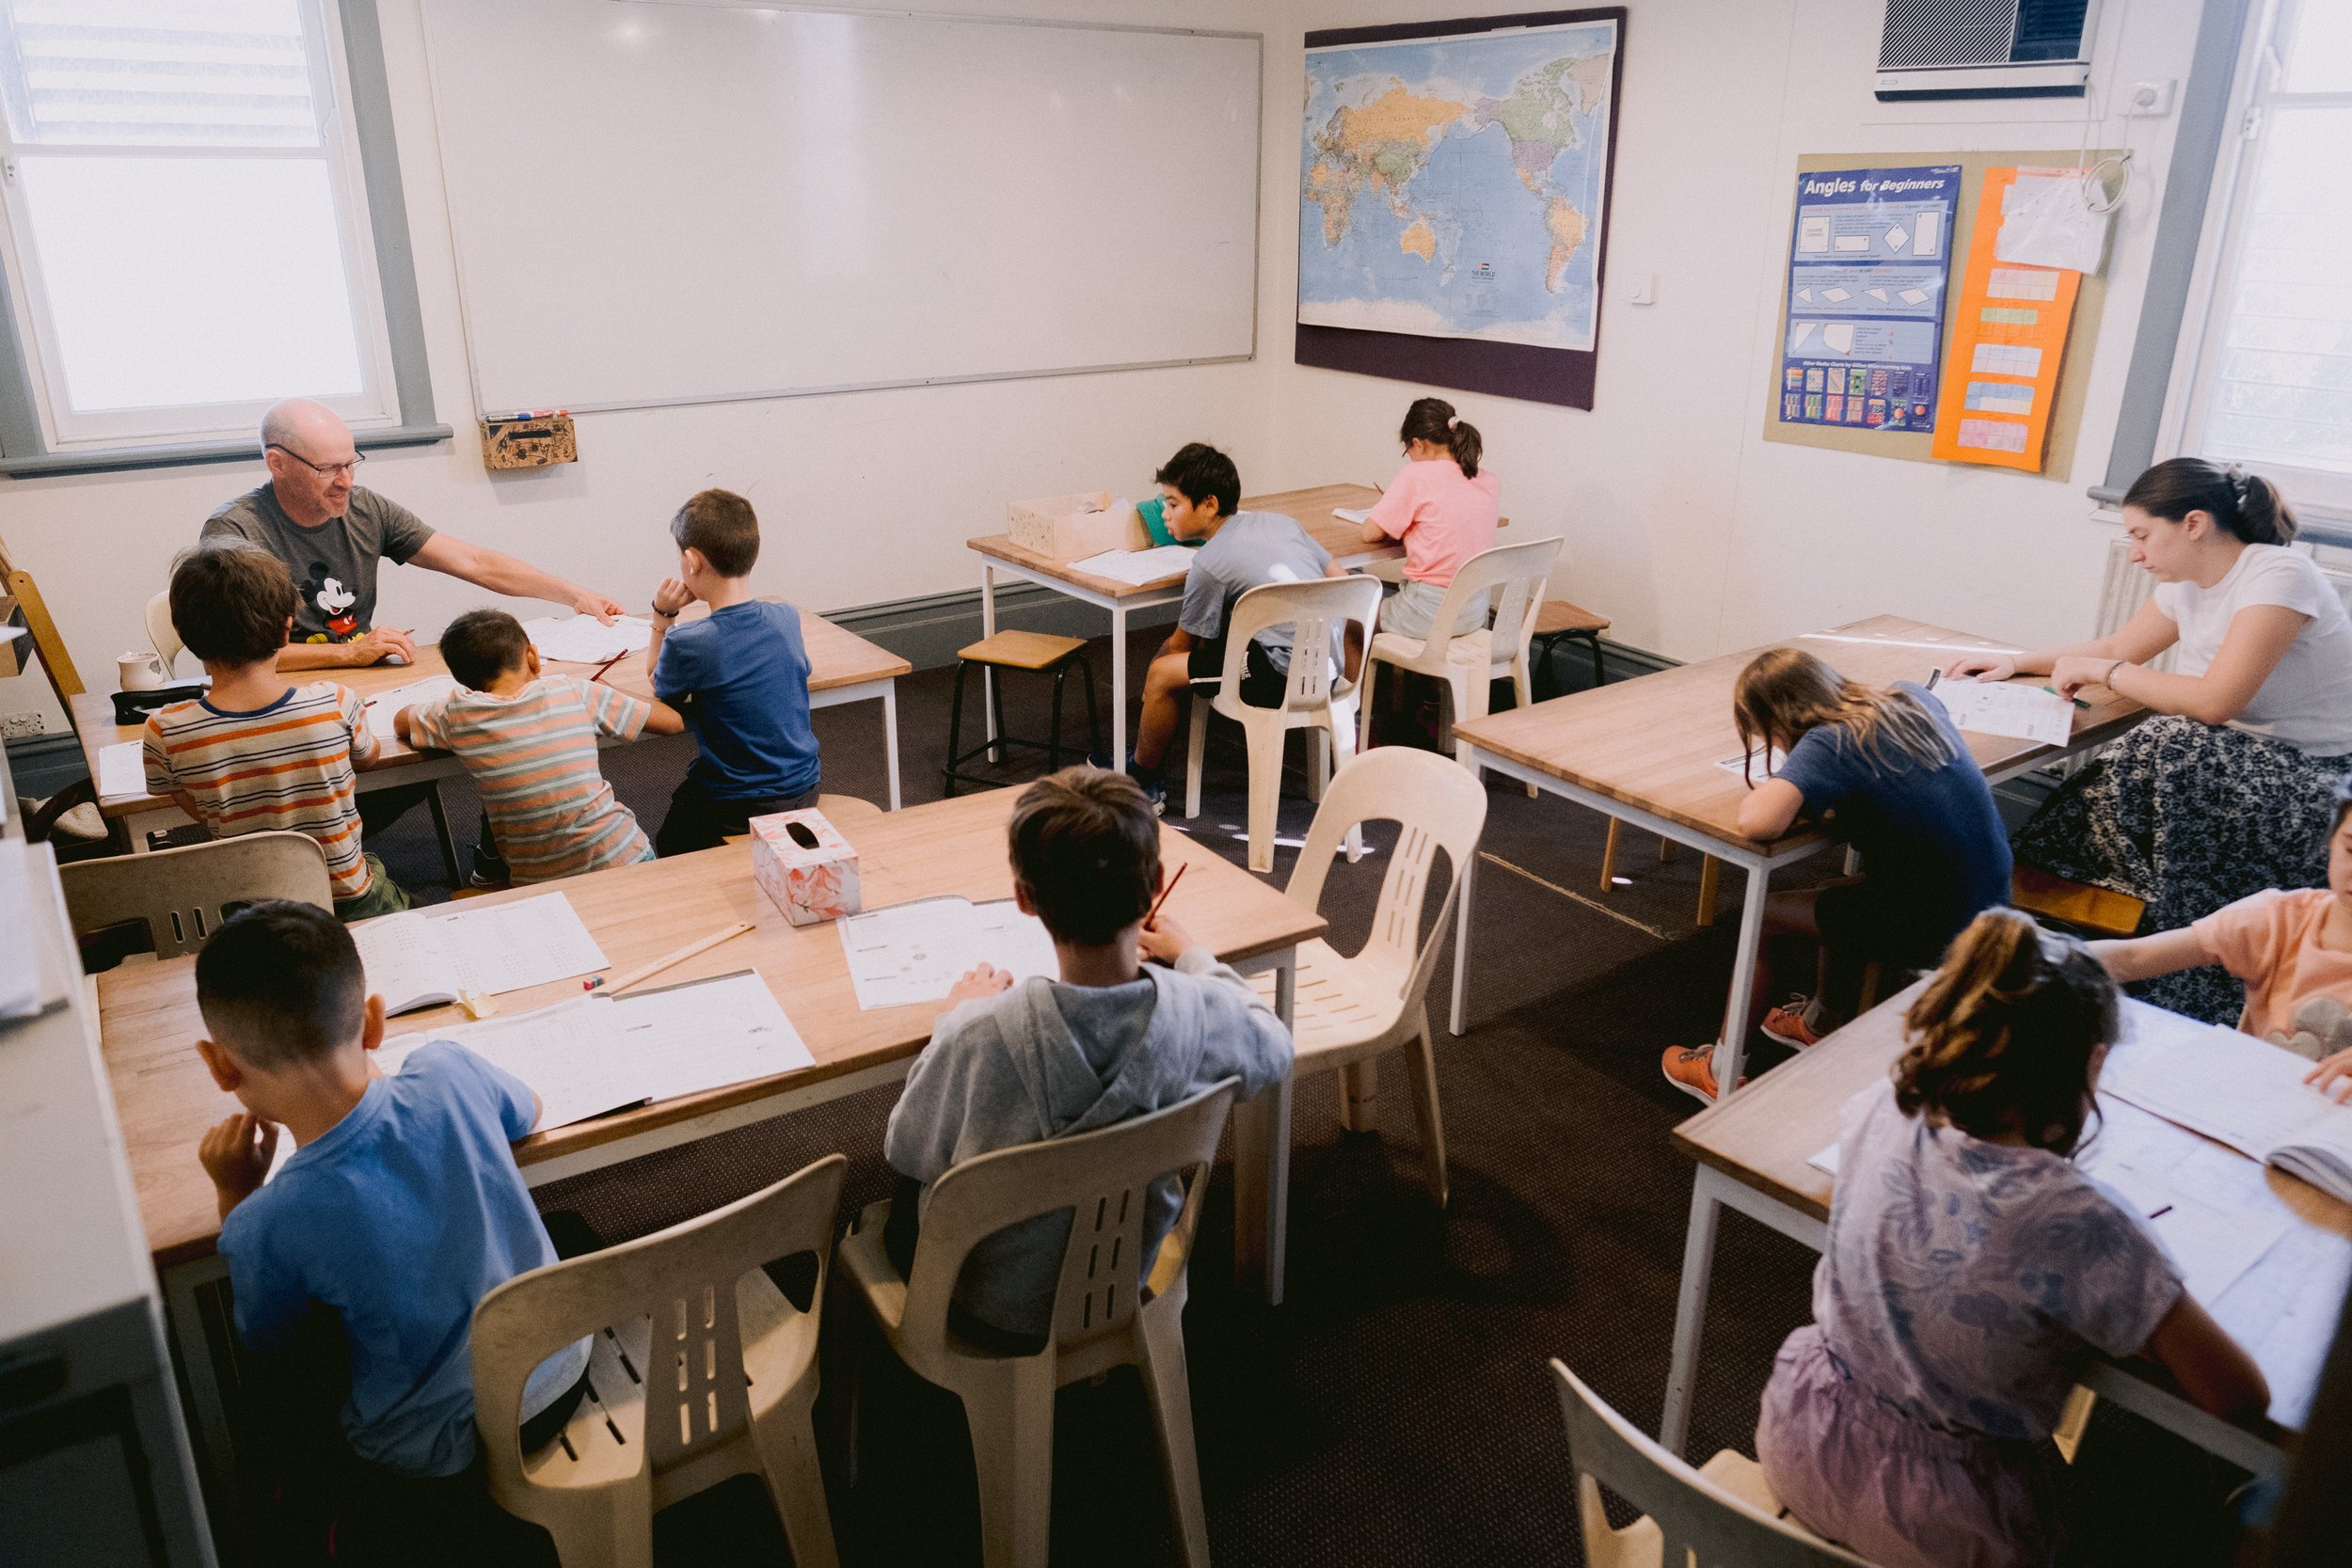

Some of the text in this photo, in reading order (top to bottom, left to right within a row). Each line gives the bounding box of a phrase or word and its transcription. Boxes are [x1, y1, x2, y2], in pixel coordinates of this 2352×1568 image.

[1804, 177, 1946, 198] Angles for Beginners
